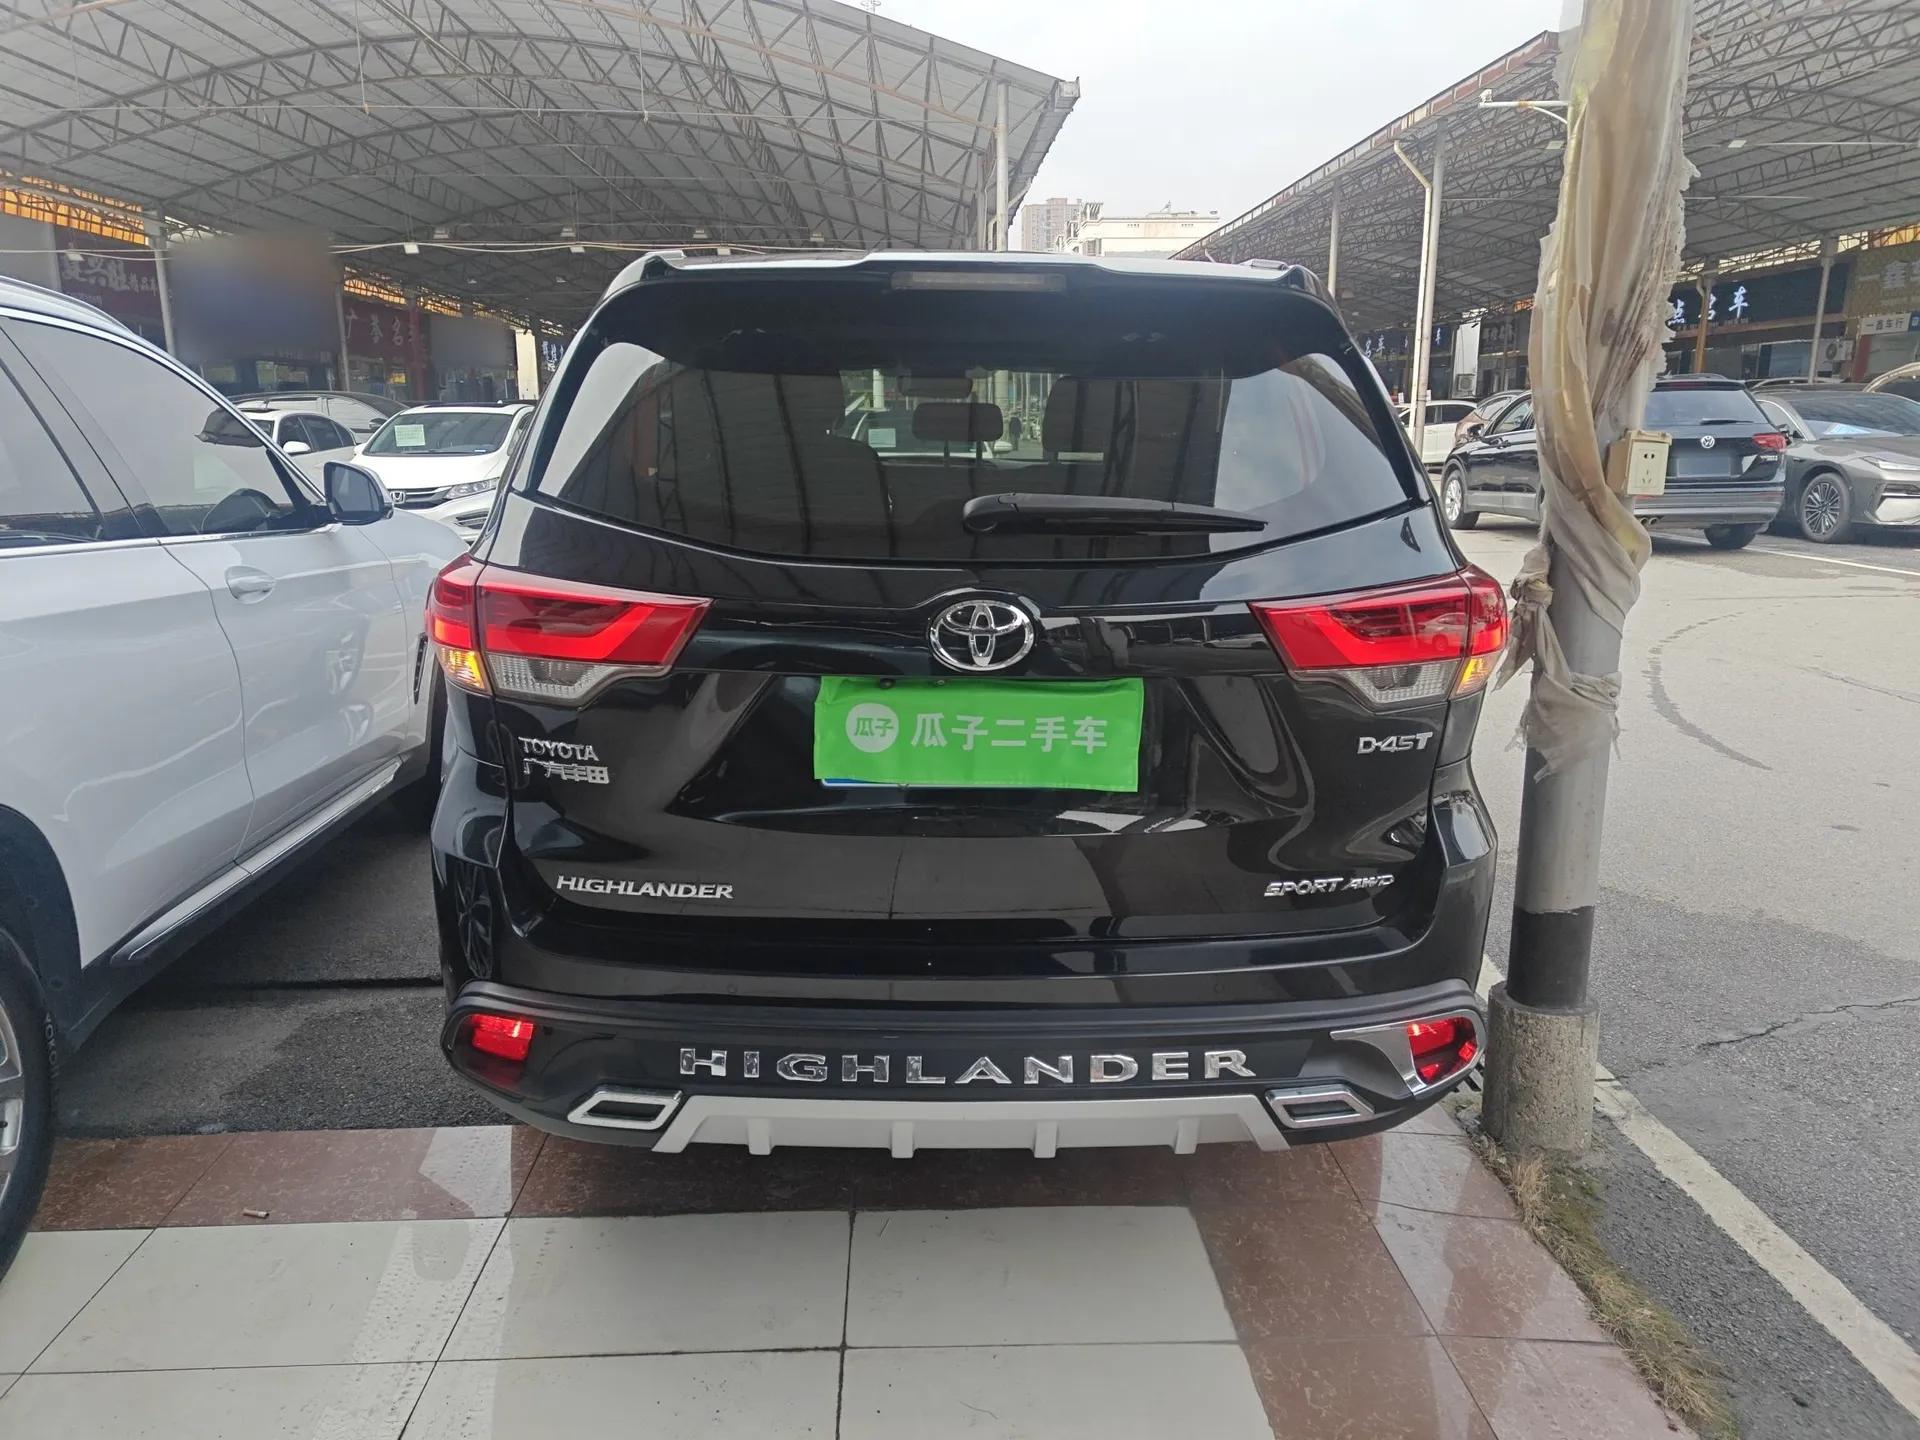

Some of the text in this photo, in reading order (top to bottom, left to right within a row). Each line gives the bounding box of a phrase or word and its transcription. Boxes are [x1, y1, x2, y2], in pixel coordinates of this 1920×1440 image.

[853, 717, 894, 737] 瓜子
[911, 712, 1108, 754] 瓜子二手车
[518, 736, 600, 761] TOYOTA
[523, 758, 609, 784] 广汽丰田
[556, 875, 735, 899] HIGHLANDER
[1264, 874, 1395, 897] SPORT AWD
[679, 1047, 1257, 1085] HIGHLANDER
